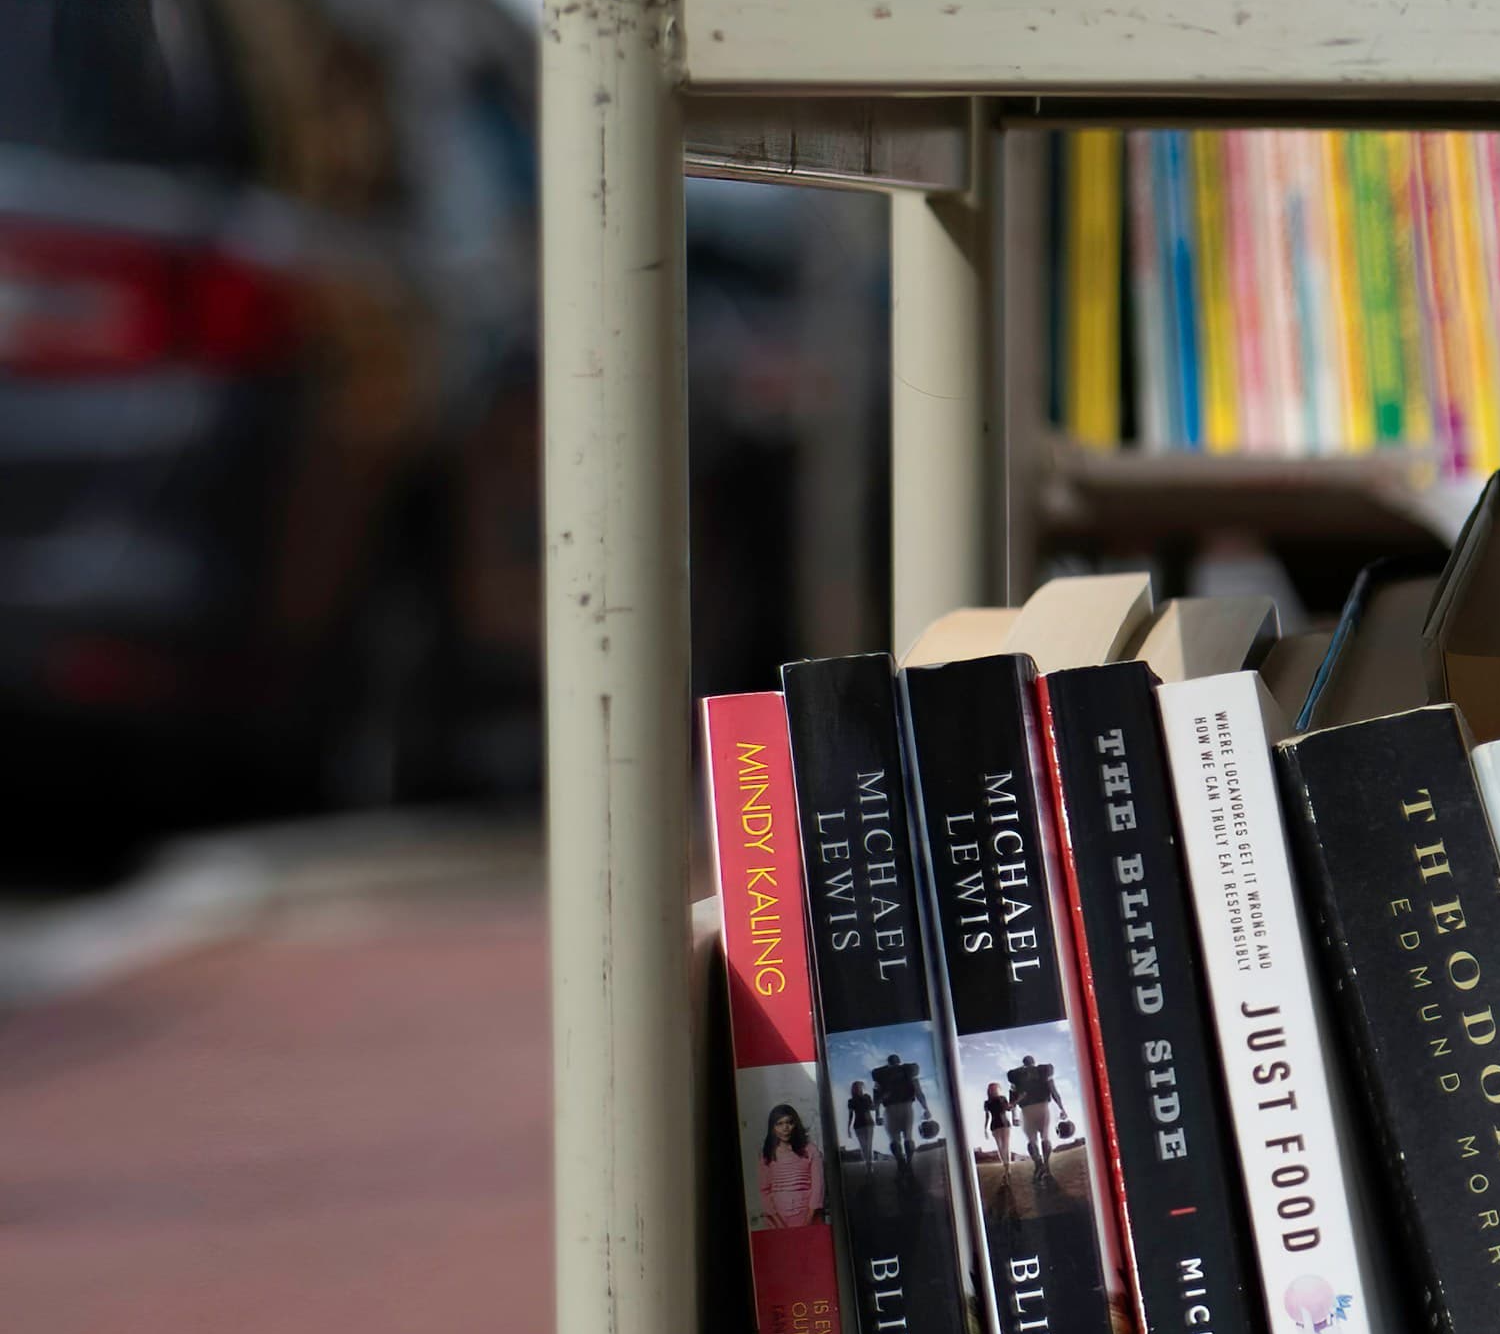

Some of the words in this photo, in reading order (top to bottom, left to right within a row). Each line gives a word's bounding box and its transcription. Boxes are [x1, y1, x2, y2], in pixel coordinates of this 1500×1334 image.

[735, 741, 775, 854] MINDY
[1097, 727, 1138, 833] THE
[745, 865, 786, 997] KALING
[815, 808, 861, 951] LEWIS
[856, 768, 908, 981] MICHAEL
[945, 811, 994, 954] LEWIS
[984, 770, 1041, 983] MICHAEL
[1115, 852, 1165, 1015] BLIND
[1240, 1001, 1298, 1111] JUST
[1389, 897, 1461, 1094] EDMUND
[1143, 1039, 1188, 1161] SIDE
[1264, 1133, 1321, 1253] FOOD
